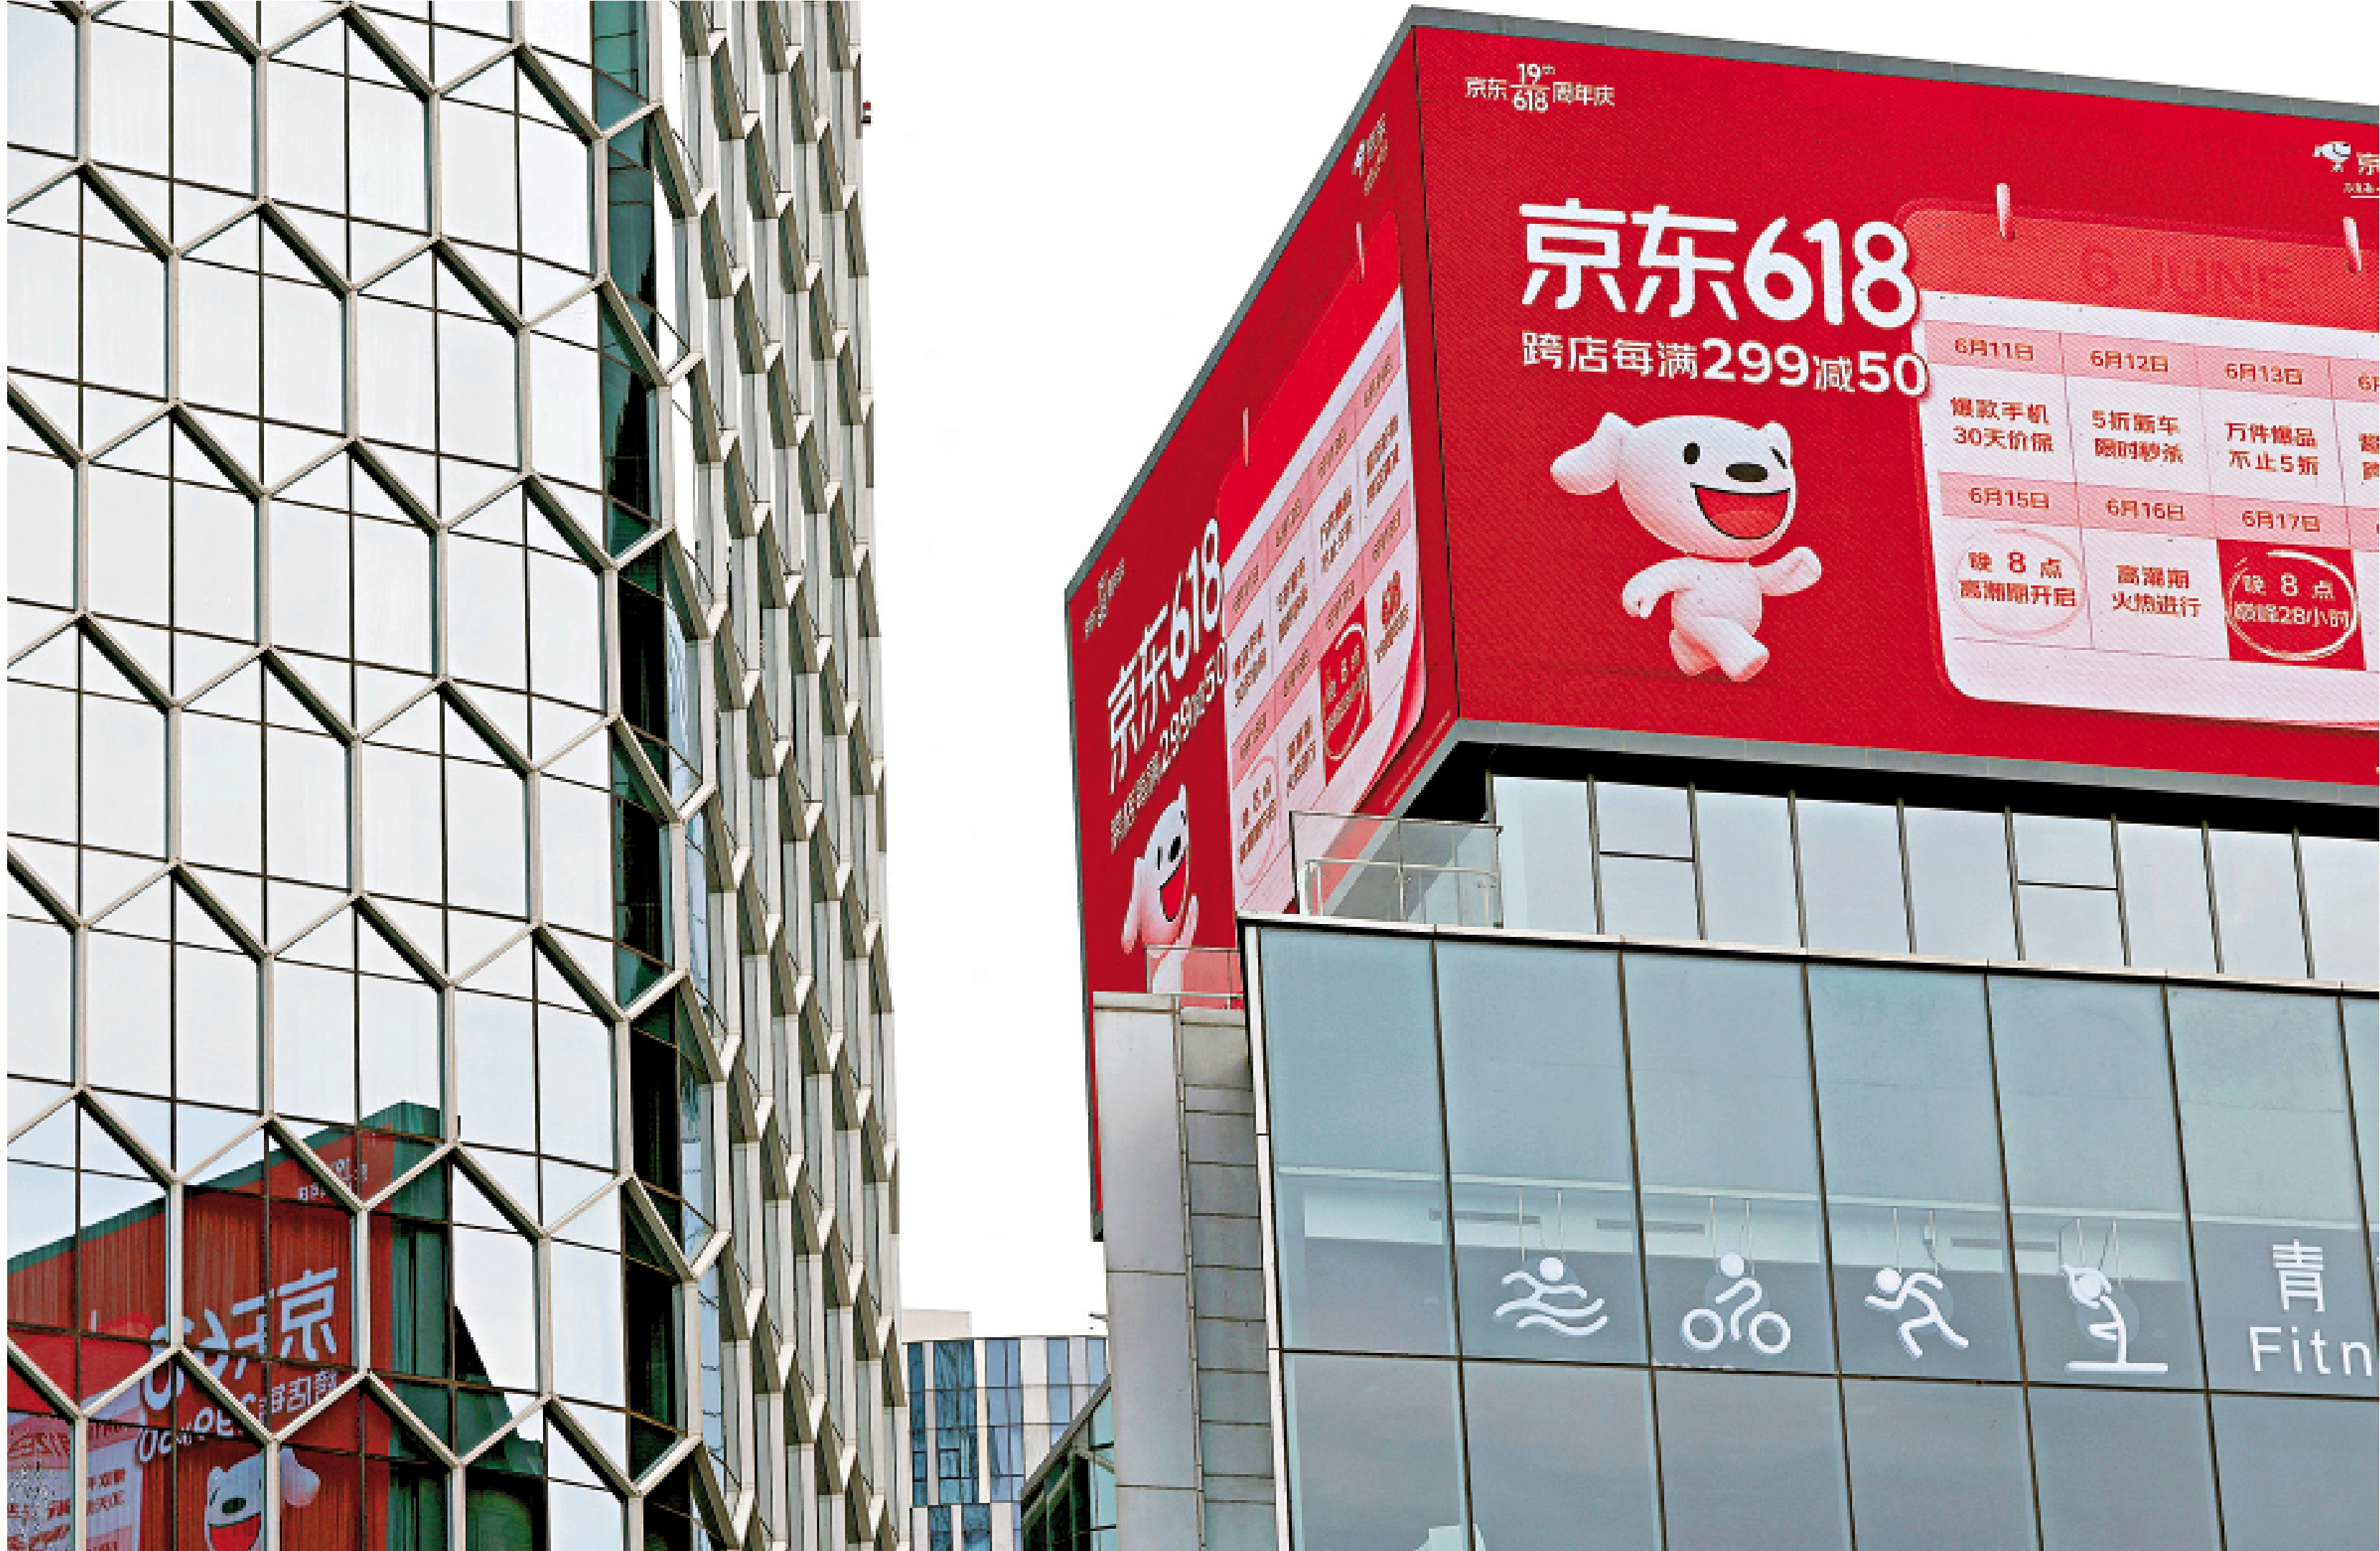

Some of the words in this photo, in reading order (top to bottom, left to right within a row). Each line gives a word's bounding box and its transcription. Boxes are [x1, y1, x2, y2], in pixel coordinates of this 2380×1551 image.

[1465, 76, 1508, 100] 京东
[1513, 88, 1549, 113] 618
[1519, 197, 1917, 329] 京东618
[1955, 337, 2034, 361] 6月11日
[2090, 350, 2170, 374] 6月12日
[1521, 331, 1930, 397] 跨店每满299减50
[2226, 362, 2303, 386] 6月13日
[1950, 397, 2051, 425] 爆款手机
[2092, 410, 2180, 436] 5折新车
[1952, 426, 2054, 454] 30天价保
[2095, 438, 2184, 465] 限时秒杀
[2229, 449, 2320, 476] 不止5折
[1968, 486, 2050, 509] 6月15日
[2107, 499, 2186, 522] 6月16日
[2242, 509, 2321, 532] 6月17日
[2116, 565, 2191, 590] 高潮期
[1958, 578, 2076, 608] 高潮期开启
[2111, 591, 2202, 618] 火热进行
[2272, 1238, 2325, 1312] 青
[2249, 1324, 2373, 1377] Fitn
